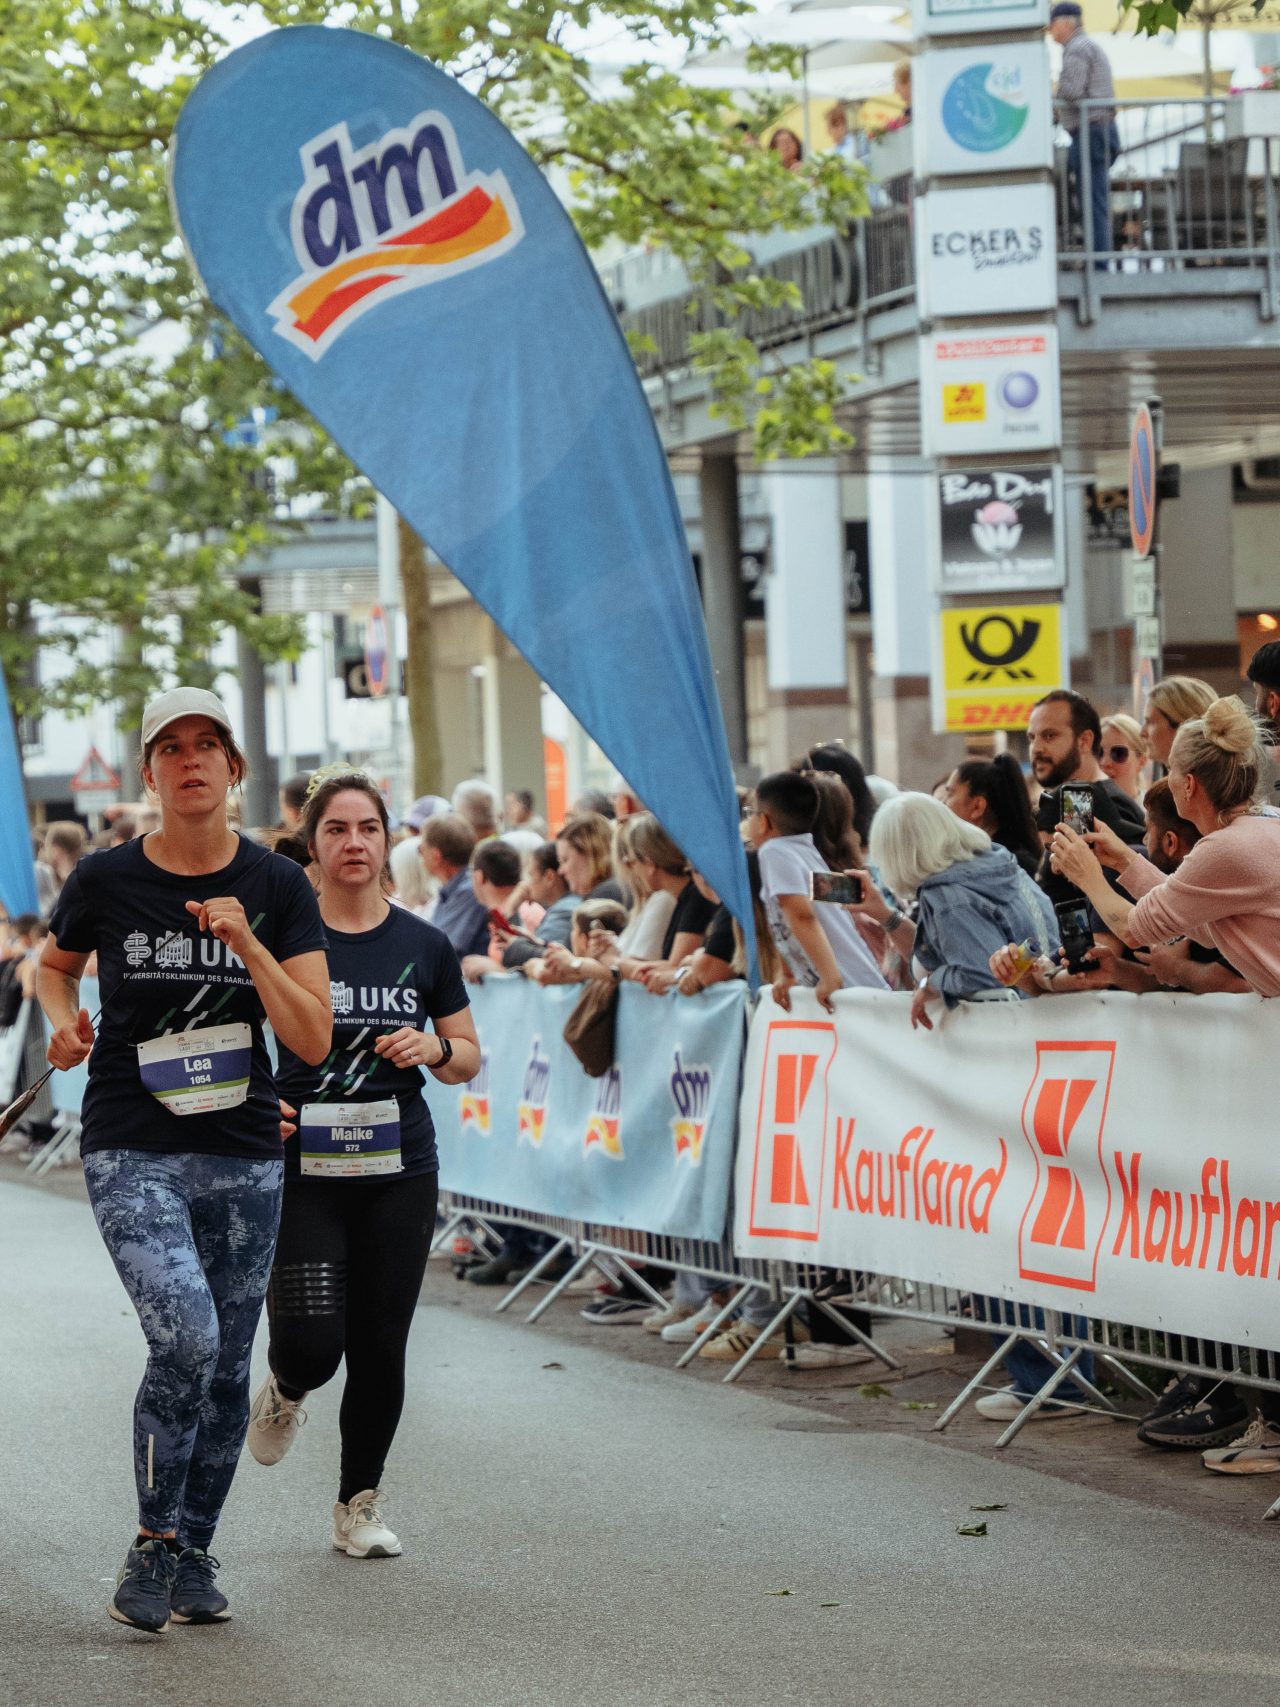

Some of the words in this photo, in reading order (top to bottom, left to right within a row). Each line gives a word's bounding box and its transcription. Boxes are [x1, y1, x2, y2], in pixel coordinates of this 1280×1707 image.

[302, 122, 459, 268] dm
[200, 938, 247, 969] UK
[207, 974, 222, 983] DES
[223, 975, 256, 987] SAARLAN
[360, 986, 418, 1014] UKS
[381, 1018, 417, 1028] SAARLANDES
[184, 1058, 212, 1073] Lea
[190, 1074, 212, 1085] 1054
[670, 1050, 711, 1119] dm
[331, 1127, 374, 1141] Maike
[345, 1144, 360, 1152] 572
[832, 1116, 1008, 1234] Kaufland
